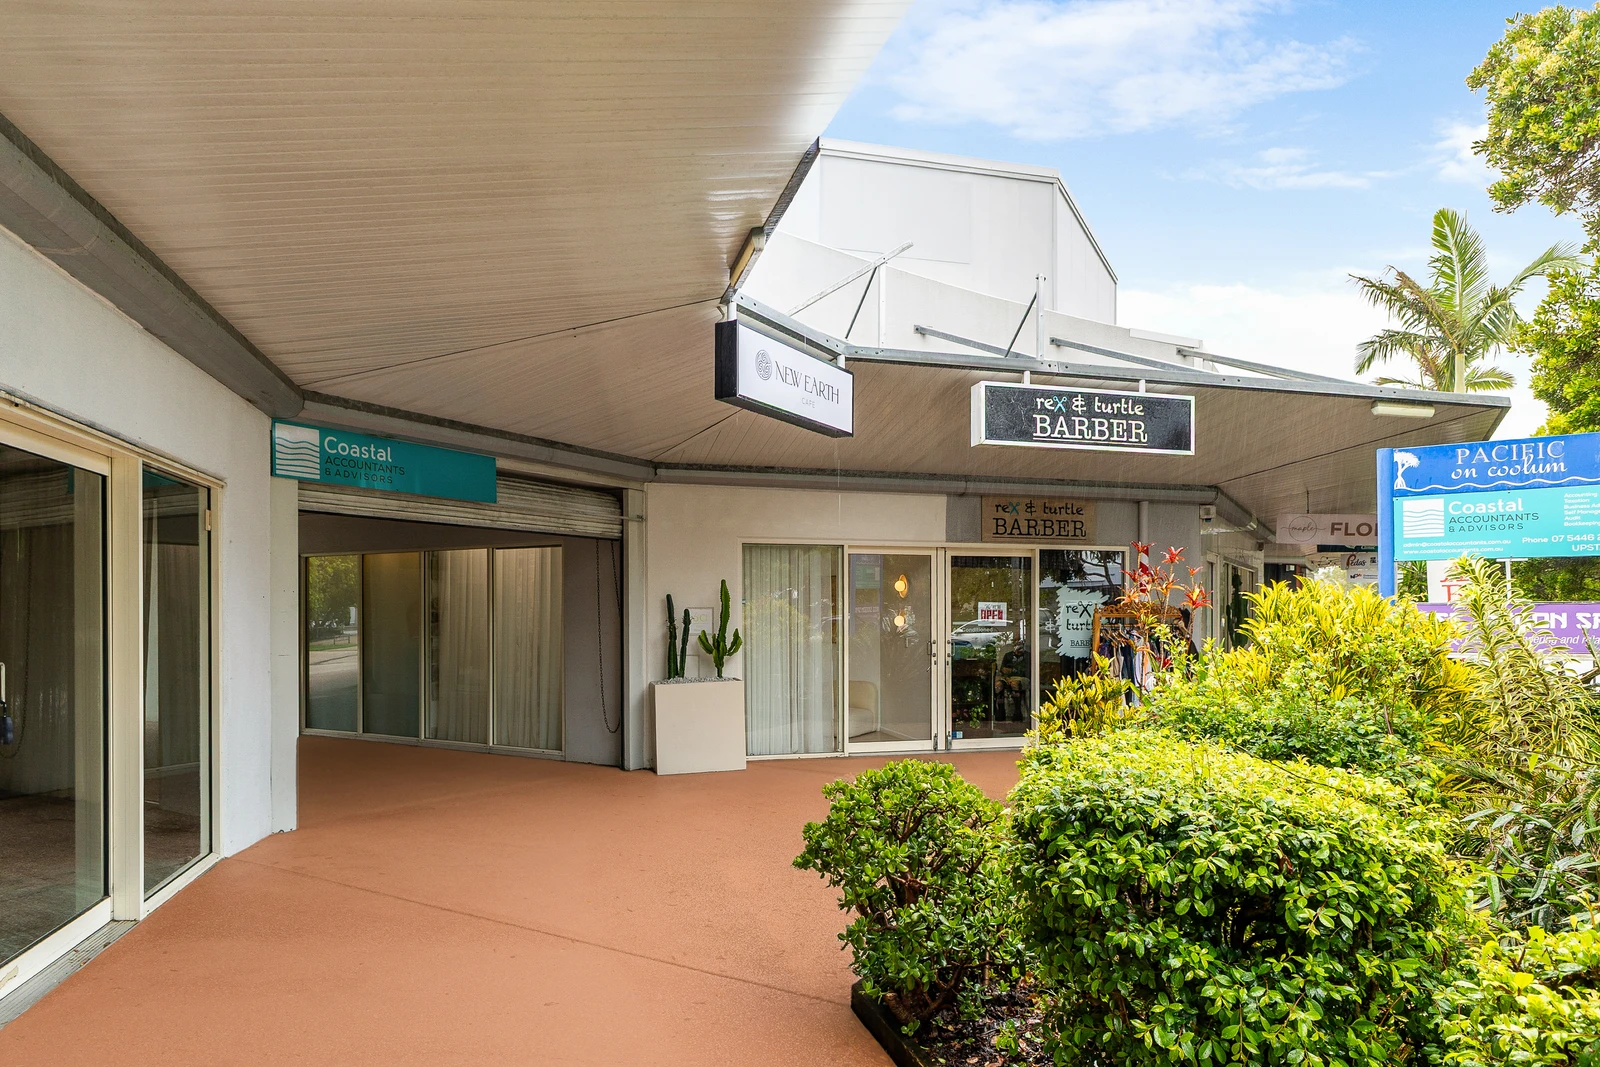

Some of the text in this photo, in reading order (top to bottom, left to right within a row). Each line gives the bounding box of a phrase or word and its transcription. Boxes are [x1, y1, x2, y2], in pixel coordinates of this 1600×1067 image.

[774, 360, 840, 405] NEW EARTH
[1072, 394, 1087, 415] &
[1094, 396, 1145, 416] turtle
[1032, 414, 1148, 443] BARBER
[323, 436, 392, 462] Coastal
[1455, 440, 1565, 465] PACIFIC
[324, 455, 406, 476] ACCOUNTANTS
[1450, 453, 1568, 480] on coolum
[324, 467, 394, 484] & ADVISORS
[1024, 500, 1037, 517] &
[1043, 501, 1084, 516] turtle
[1448, 497, 1524, 515] Coastal
[1448, 512, 1540, 525] ACCOUNTANTS
[992, 517, 1087, 538] BARBER
[1330, 521, 1378, 537] FLO
[1448, 522, 1524, 533] & ADVISORS
[1521, 536, 1548, 544] Phone
[1551, 534, 1565, 543] 07
[1567, 533, 1595, 542] 5446
[1066, 618, 1092, 631] turt
[1070, 639, 1091, 647] BARB
[1561, 635, 1580, 644] and
